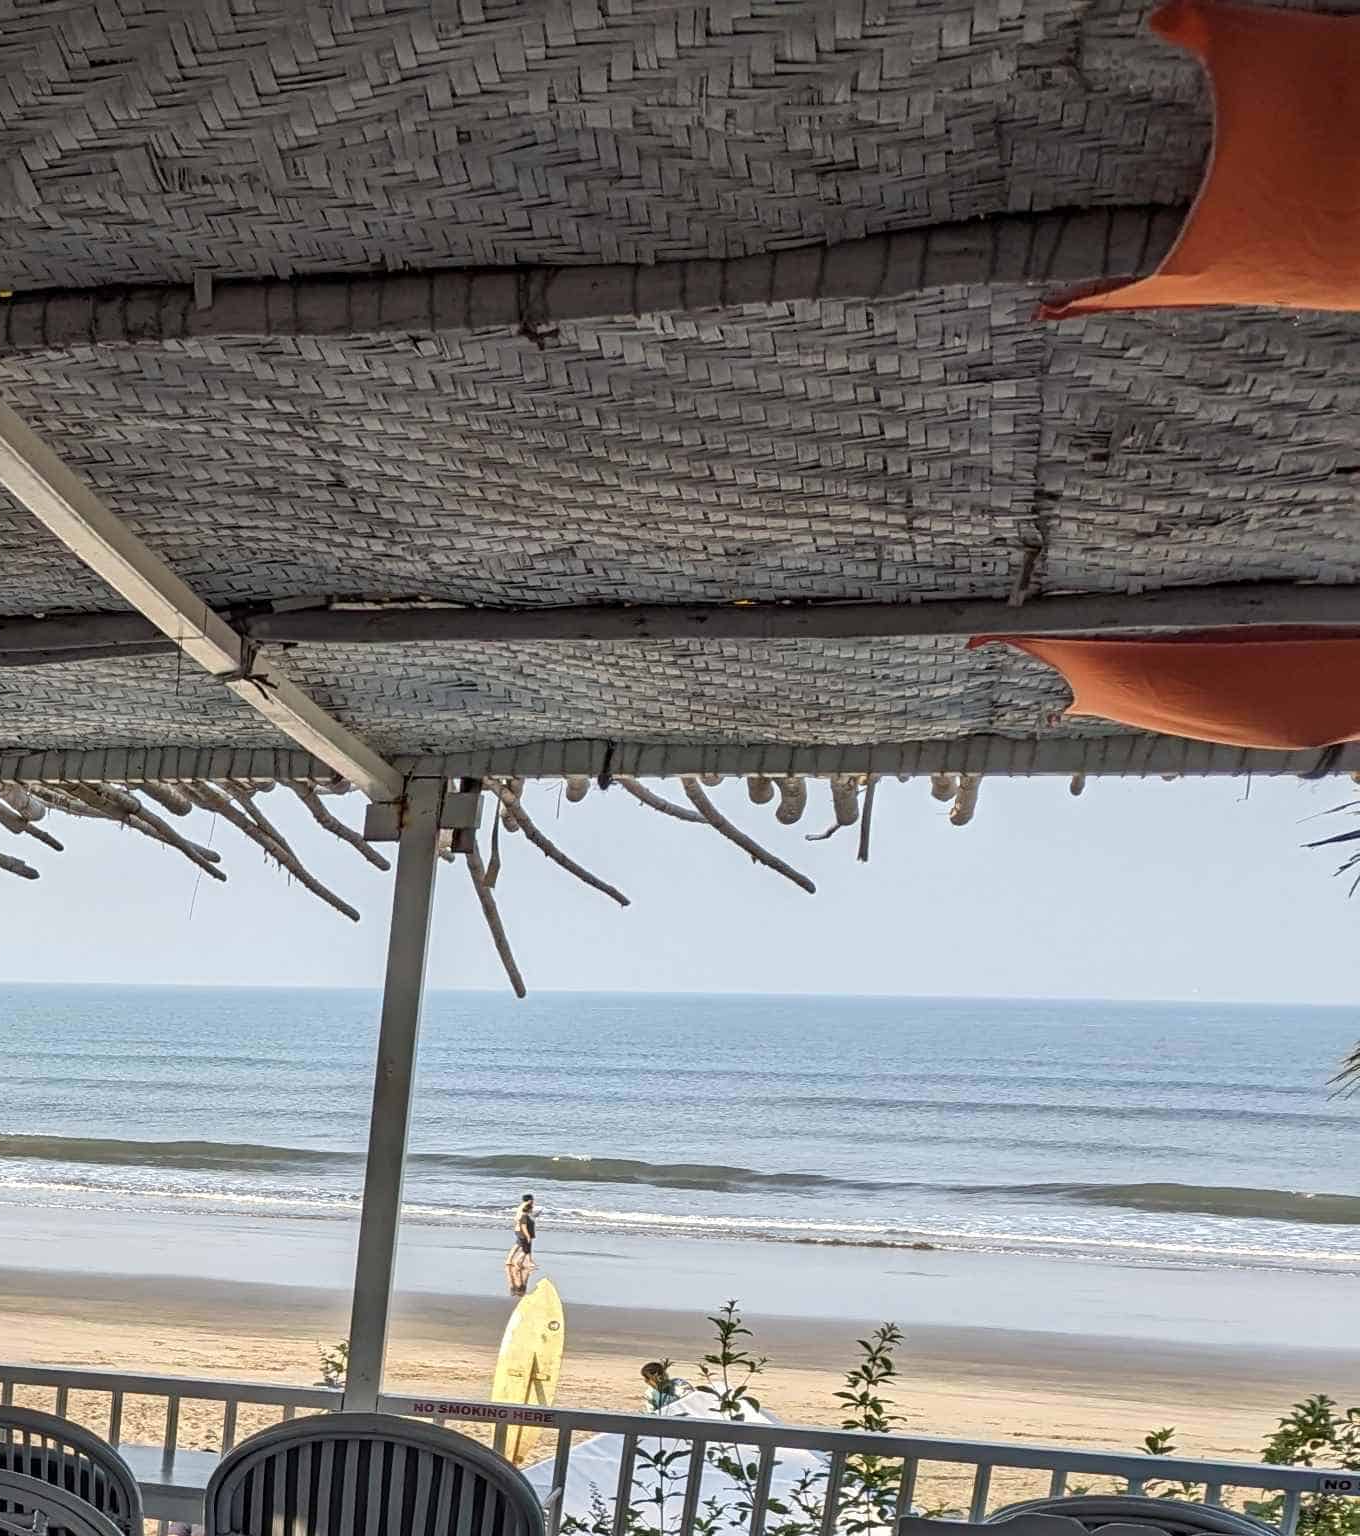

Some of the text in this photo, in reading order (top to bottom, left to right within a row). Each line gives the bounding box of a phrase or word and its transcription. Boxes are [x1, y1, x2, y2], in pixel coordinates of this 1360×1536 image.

[413, 1402, 553, 1423] NO SMOKING HERE
[1325, 1480, 1351, 1490] NO
